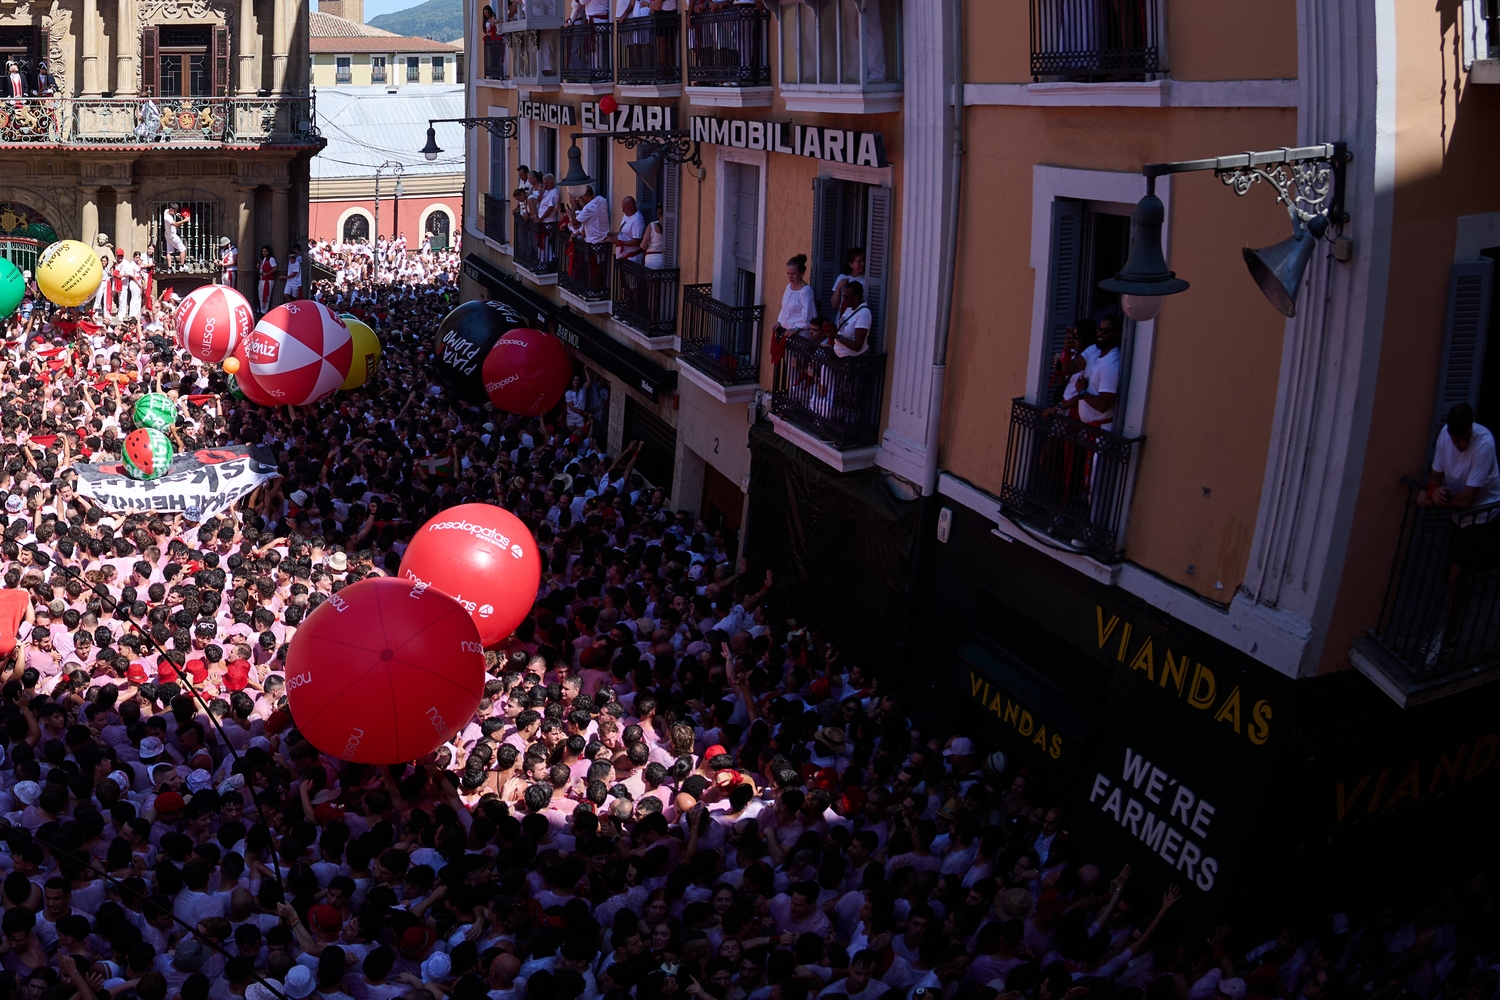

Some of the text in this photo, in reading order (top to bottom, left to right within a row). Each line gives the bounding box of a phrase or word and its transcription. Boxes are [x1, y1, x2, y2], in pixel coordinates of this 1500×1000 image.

[518, 101, 878, 167] AGENCIA ELIZARI INMOBILIARIA
[60, 271, 78, 289] FERMIN
[63, 276, 83, 292] FERMIN
[201, 317, 216, 357] QUESOS
[443, 330, 481, 361] PLOMO
[556, 324, 580, 349] BAR MOL
[443, 348, 478, 376] PLATA
[714, 438, 719, 454] 2
[92, 492, 185, 510] HERRIA
[428, 519, 510, 547] nosolopatas
[475, 532, 507, 551] descanso
[1096, 605, 1273, 745] VIANDAS
[970, 671, 1063, 759] VIANDAS
[1335, 733, 1500, 823] VIAND
[1122, 747, 1216, 839] WE'RE
[1089, 773, 1219, 892] FARMERS
